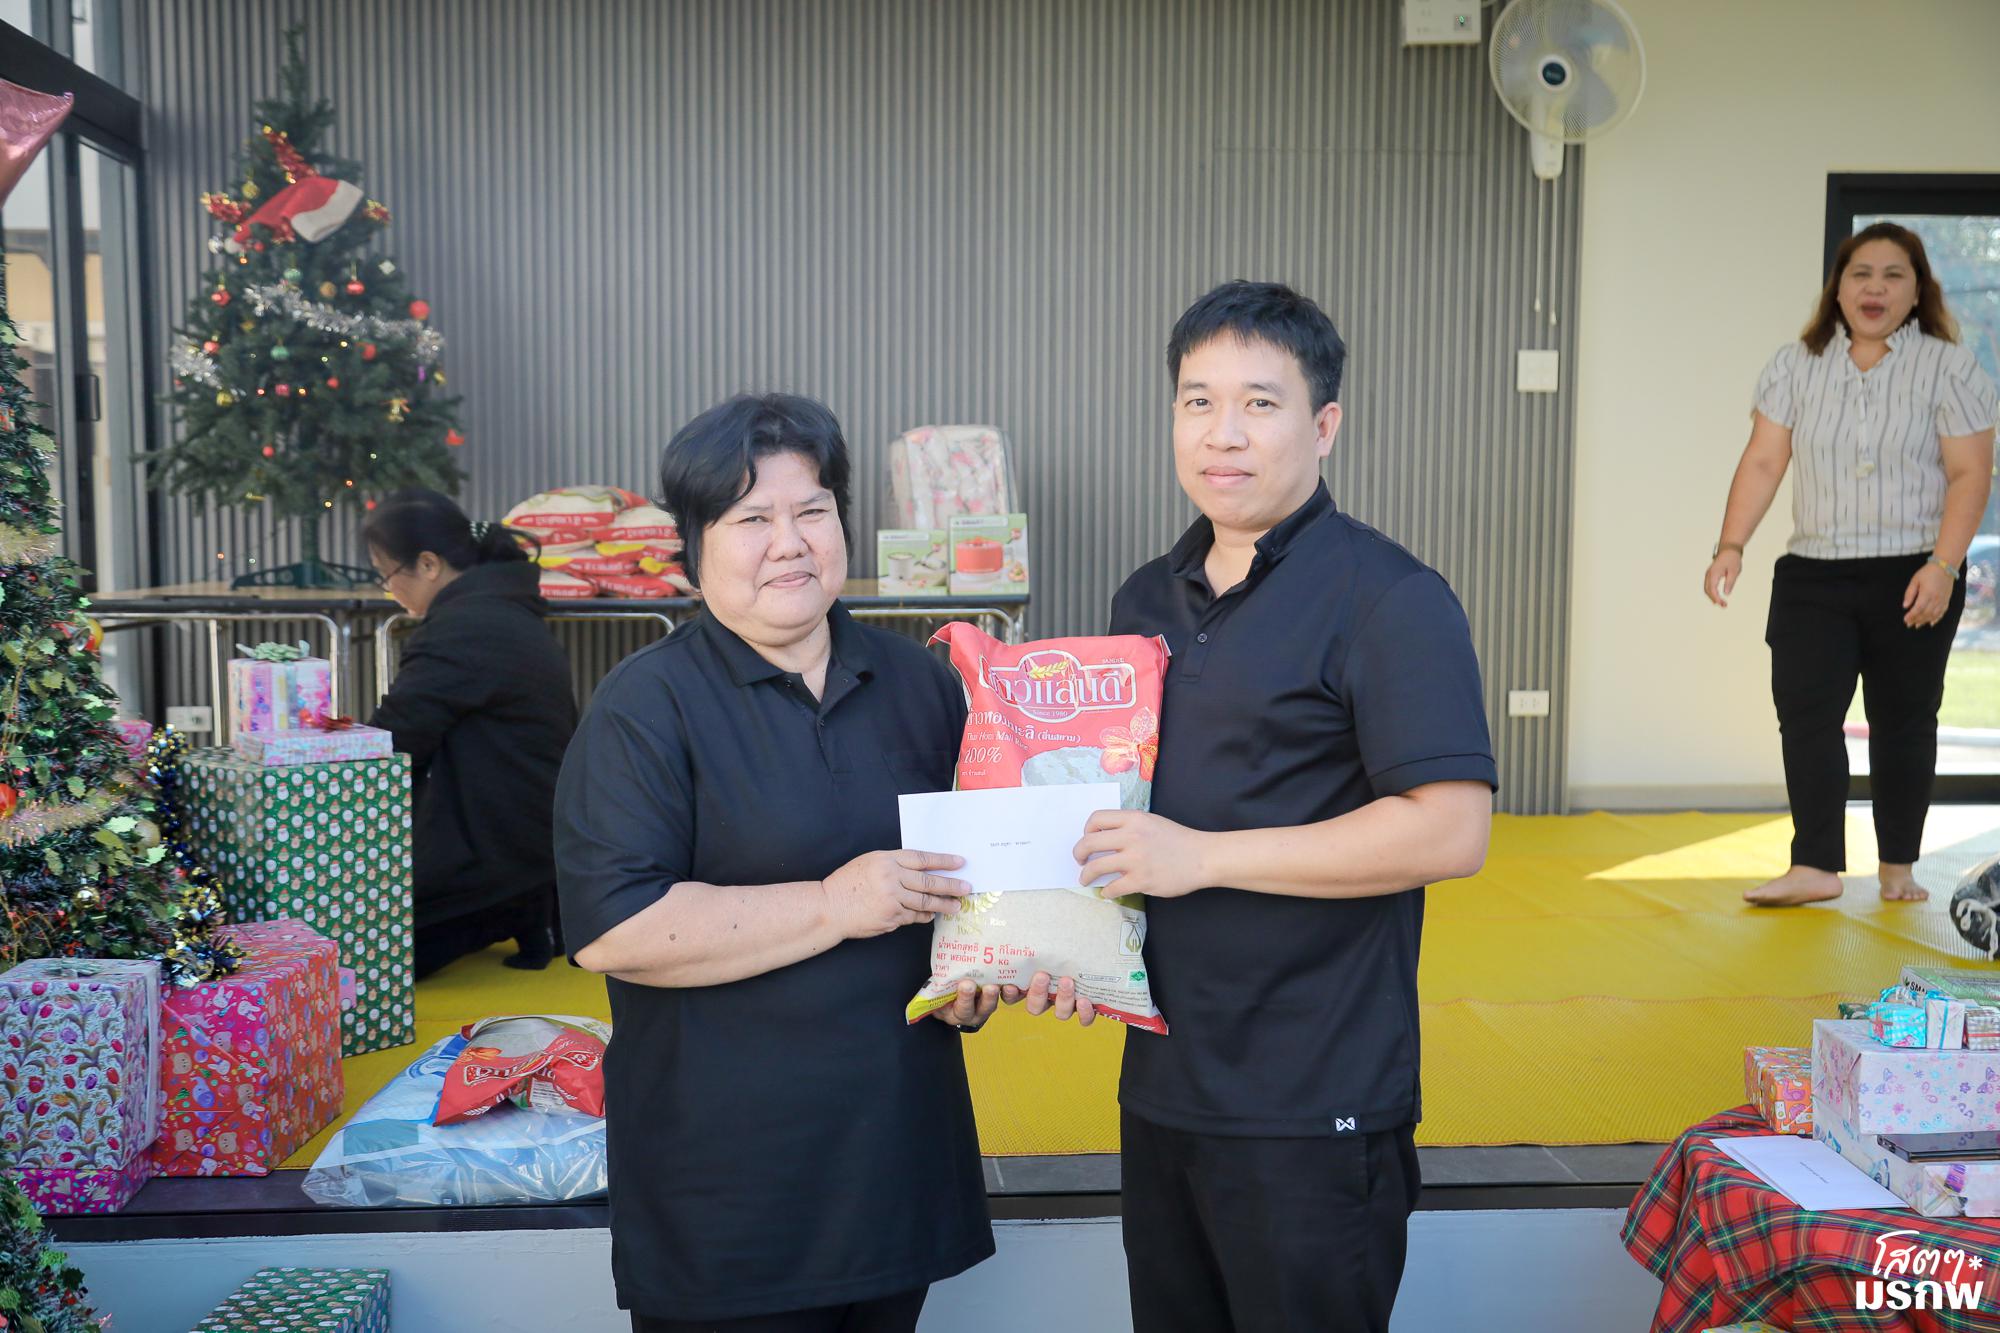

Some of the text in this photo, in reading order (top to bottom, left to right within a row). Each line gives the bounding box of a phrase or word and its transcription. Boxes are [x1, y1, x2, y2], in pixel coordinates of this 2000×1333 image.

[964, 746, 1002, 764] 100%
[936, 952, 977, 964] NET WEIGHT
[983, 947, 994, 965] 5
[998, 943, 1036, 958] กิโลกรัม
